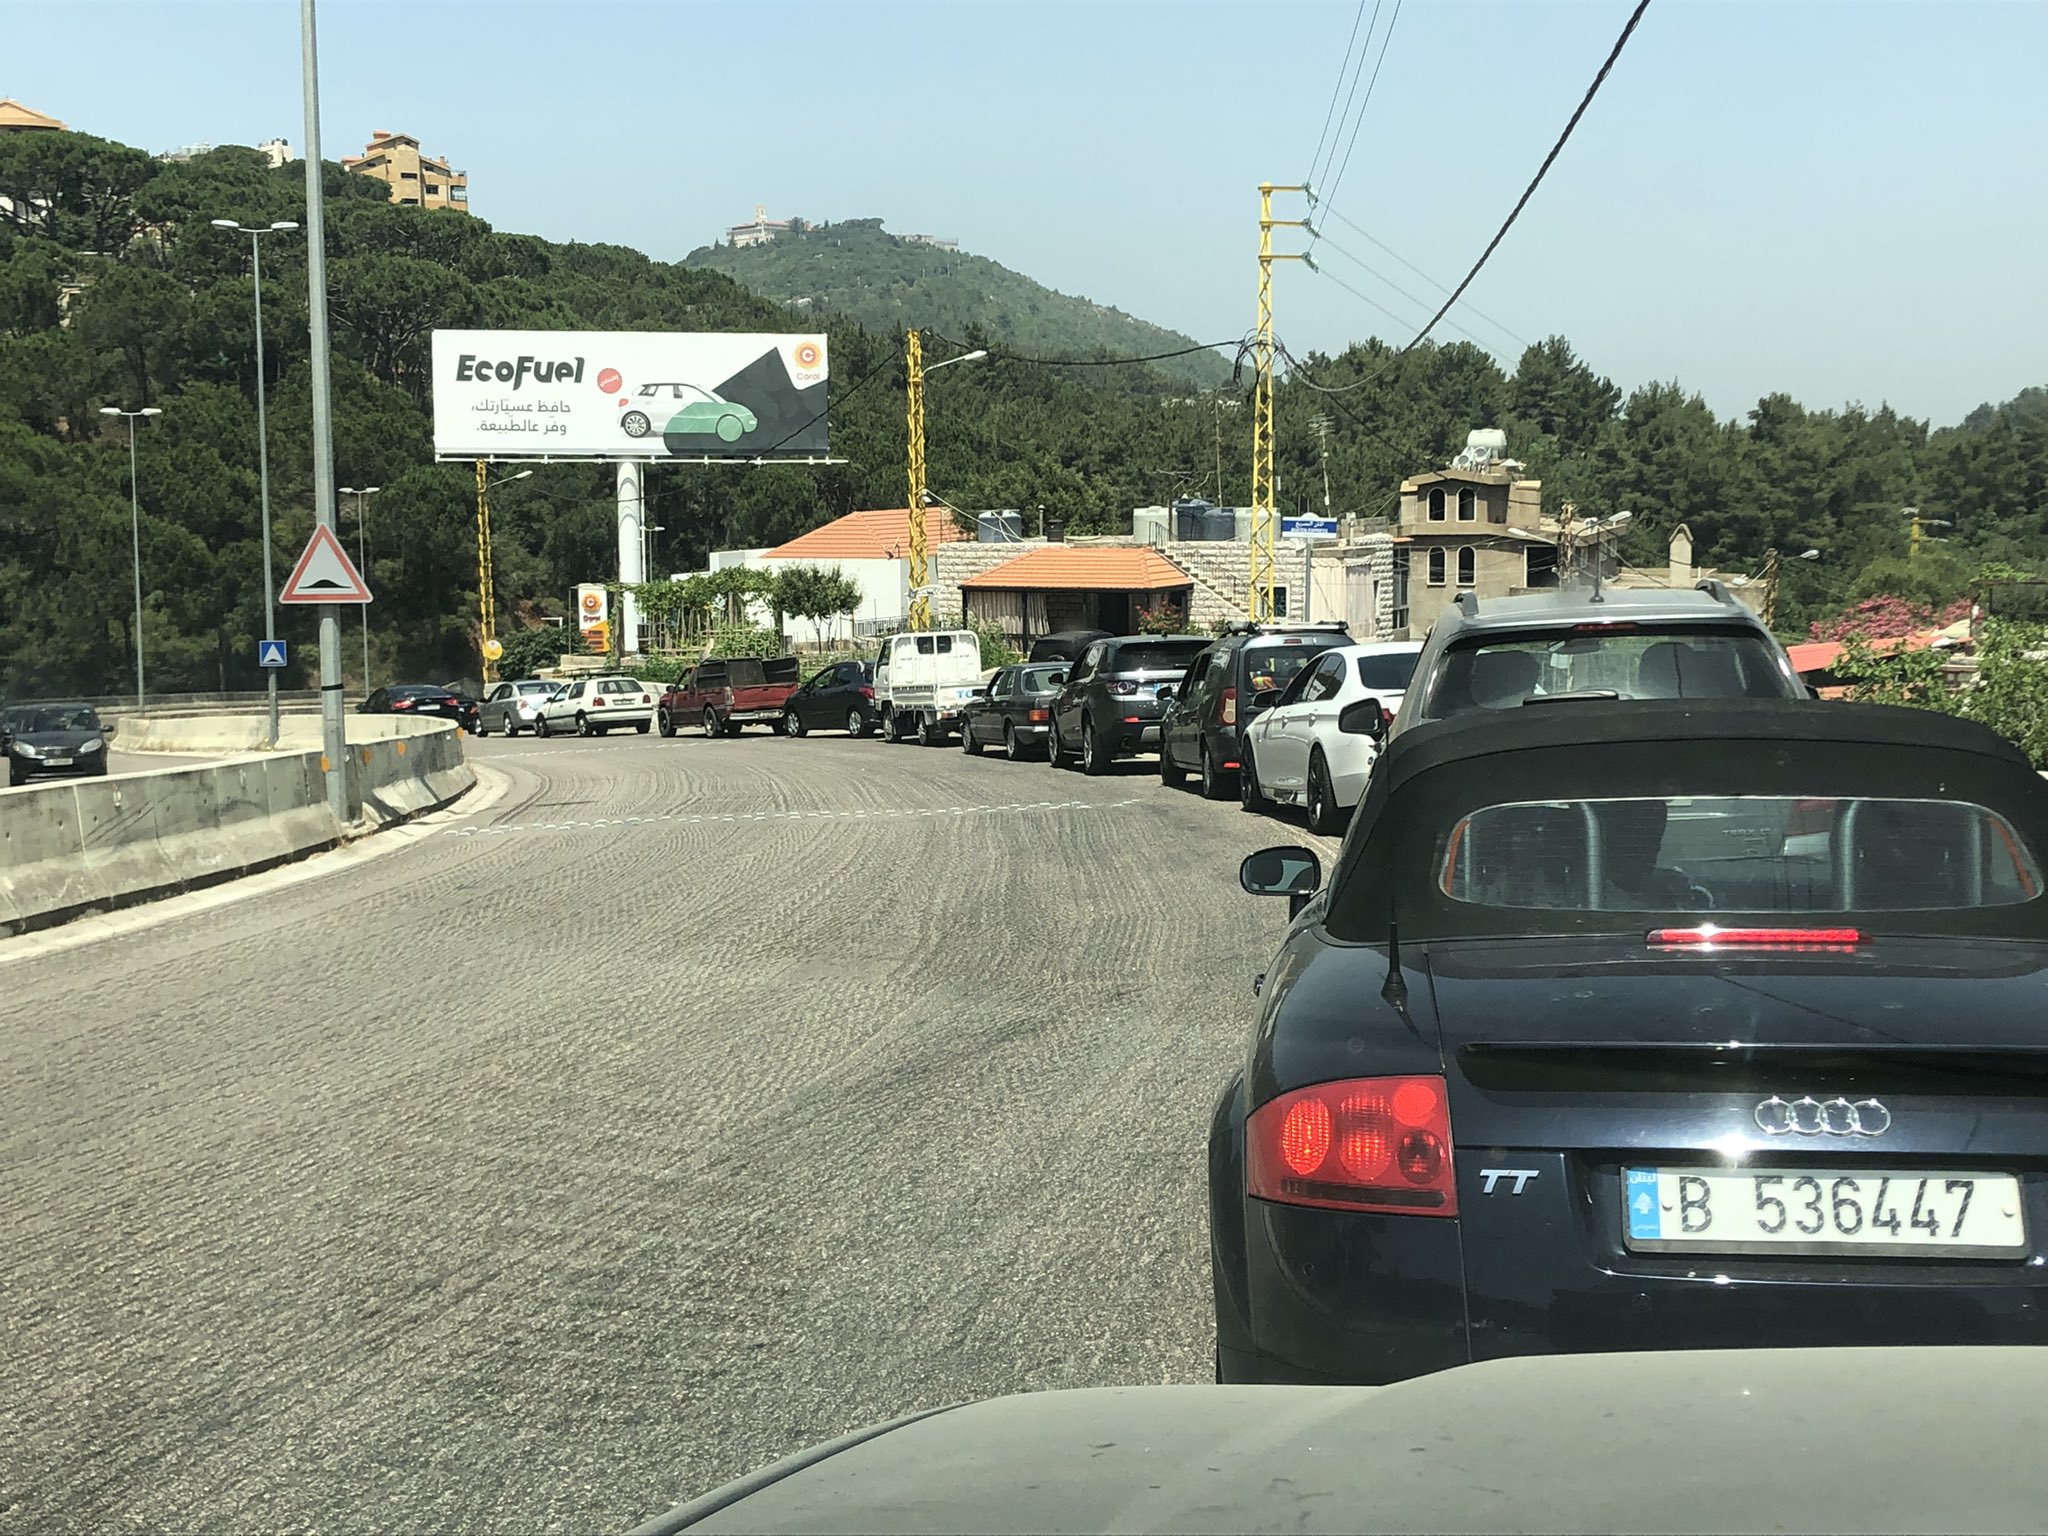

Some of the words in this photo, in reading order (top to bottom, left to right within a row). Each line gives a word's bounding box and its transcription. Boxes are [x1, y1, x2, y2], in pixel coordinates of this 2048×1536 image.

[456, 354, 585, 391] EcoFuel
[796, 373, 820, 381] Coral
[1480, 1169, 1540, 1194] TT
[1679, 1175, 1713, 1233] B
[1754, 1175, 1975, 1238] 536447
